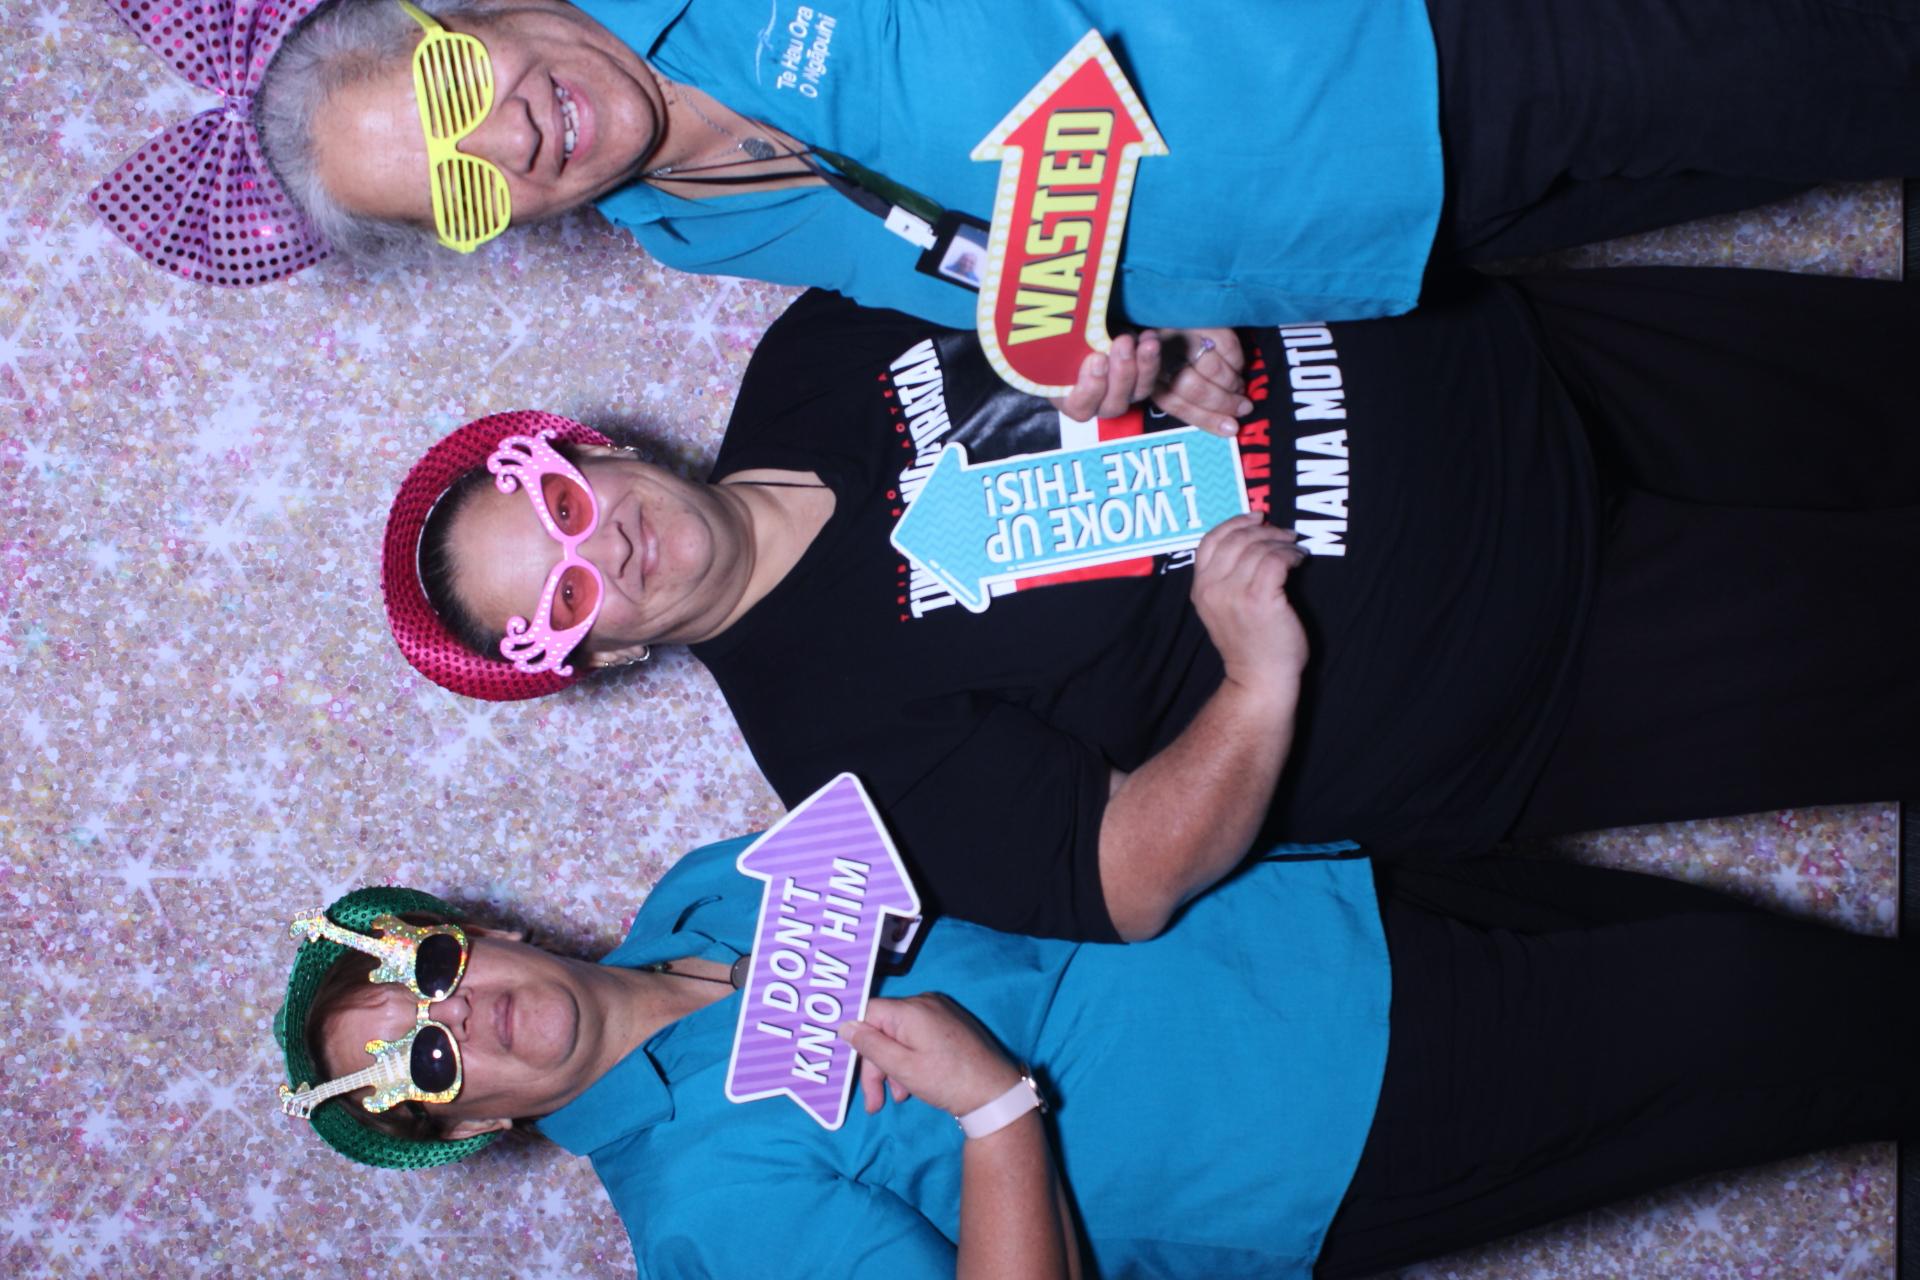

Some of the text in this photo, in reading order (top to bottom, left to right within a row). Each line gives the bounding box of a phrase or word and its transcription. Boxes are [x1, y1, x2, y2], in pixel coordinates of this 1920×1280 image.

[777, 5, 814, 89] Te Hau Ora
[799, 83, 818, 98] O
[1007, 109, 1115, 345] WASTED
[983, 442, 1192, 517] LIKE THIS!
[1278, 321, 1349, 556] MANA MOTU
[985, 485, 1202, 564] I WOKE UP
[757, 876, 821, 1039] I DON'T
[791, 857, 871, 1085] KNOW HIM
